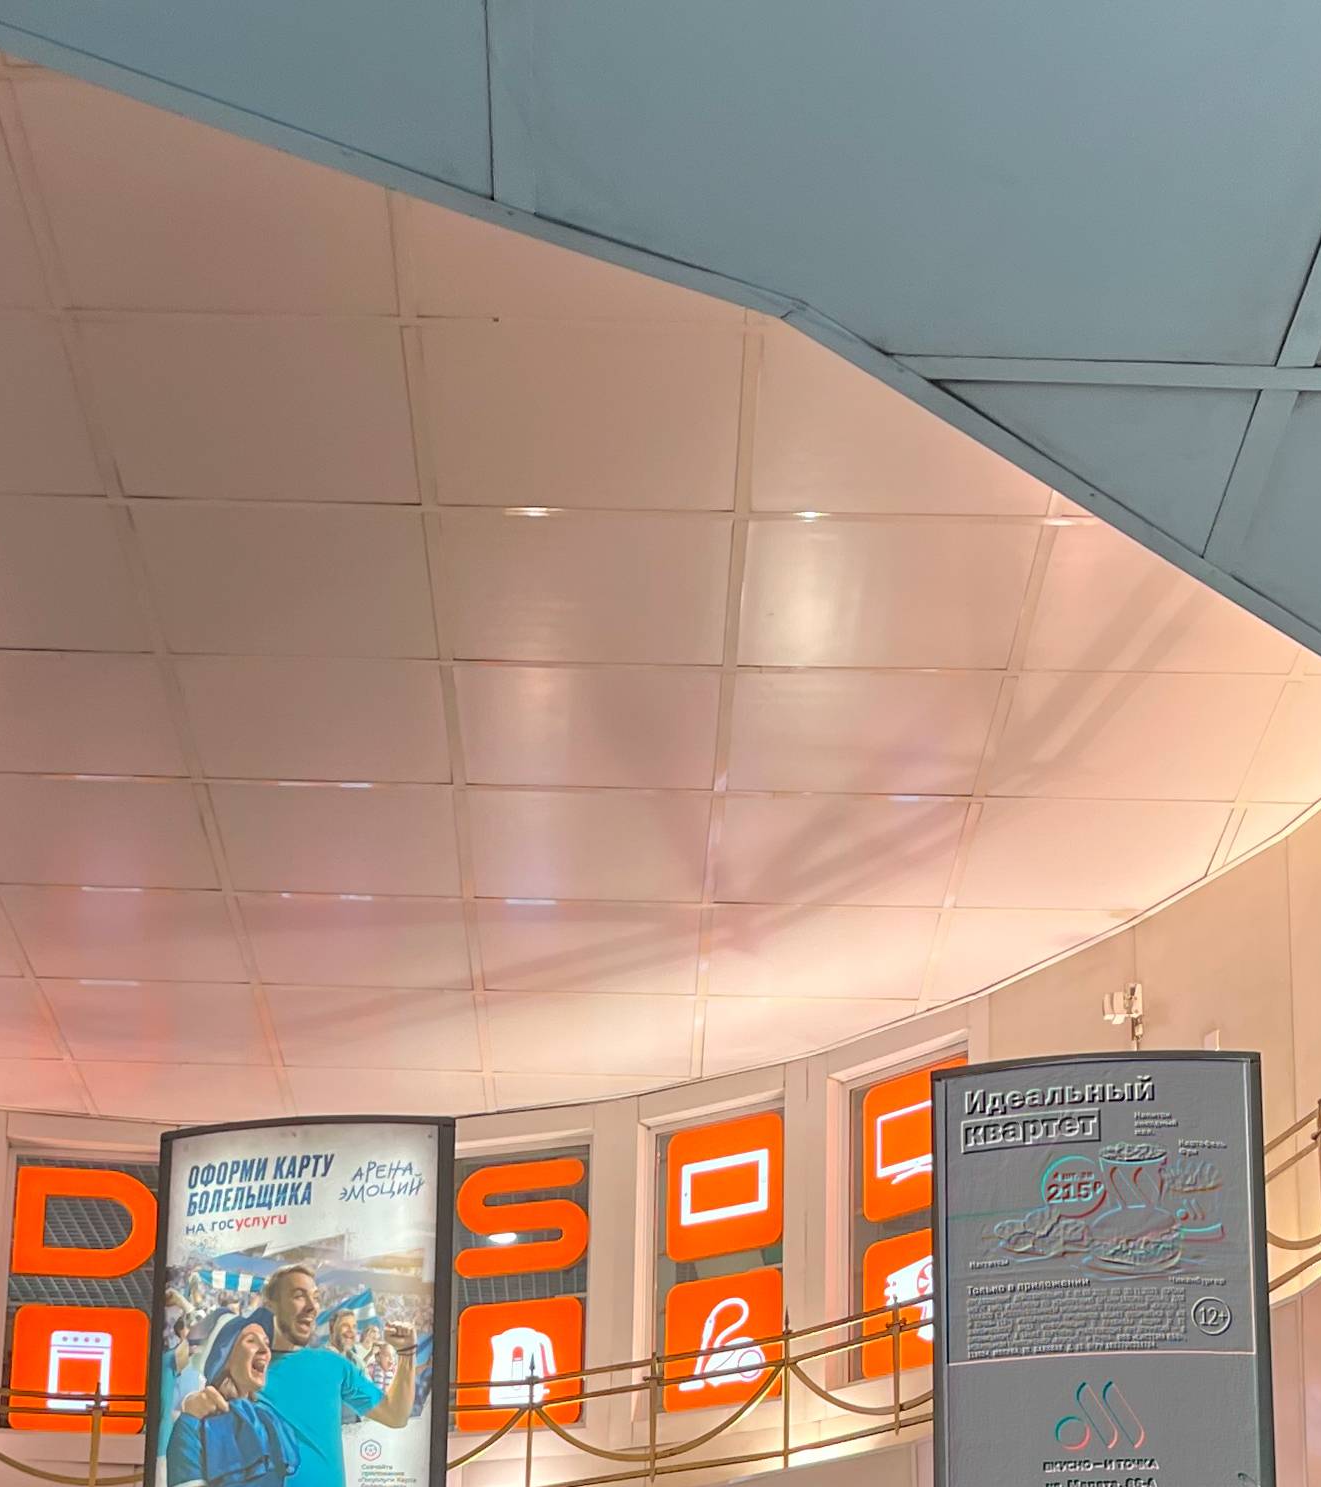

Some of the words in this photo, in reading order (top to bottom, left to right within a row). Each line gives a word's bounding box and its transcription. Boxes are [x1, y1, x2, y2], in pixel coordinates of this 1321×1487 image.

[964, 1075, 1155, 1115] Идеальный
[964, 1114, 1097, 1146] квартет
[188, 1158, 268, 1189] ОФОРМИ
[273, 1154, 335, 1181] КАРТУ
[351, 1160, 413, 1183] АРЕНА
[187, 1181, 312, 1217] БОЛЕЛЬЩИКА
[339, 1173, 425, 1203] ЭМОЦИЙ
[211, 1214, 287, 1232] госуслуги
[966, 1284, 1006, 1296] Только
[1017, 1278, 1091, 1293] приложении
[1199, 1307, 1228, 1326] 12+
